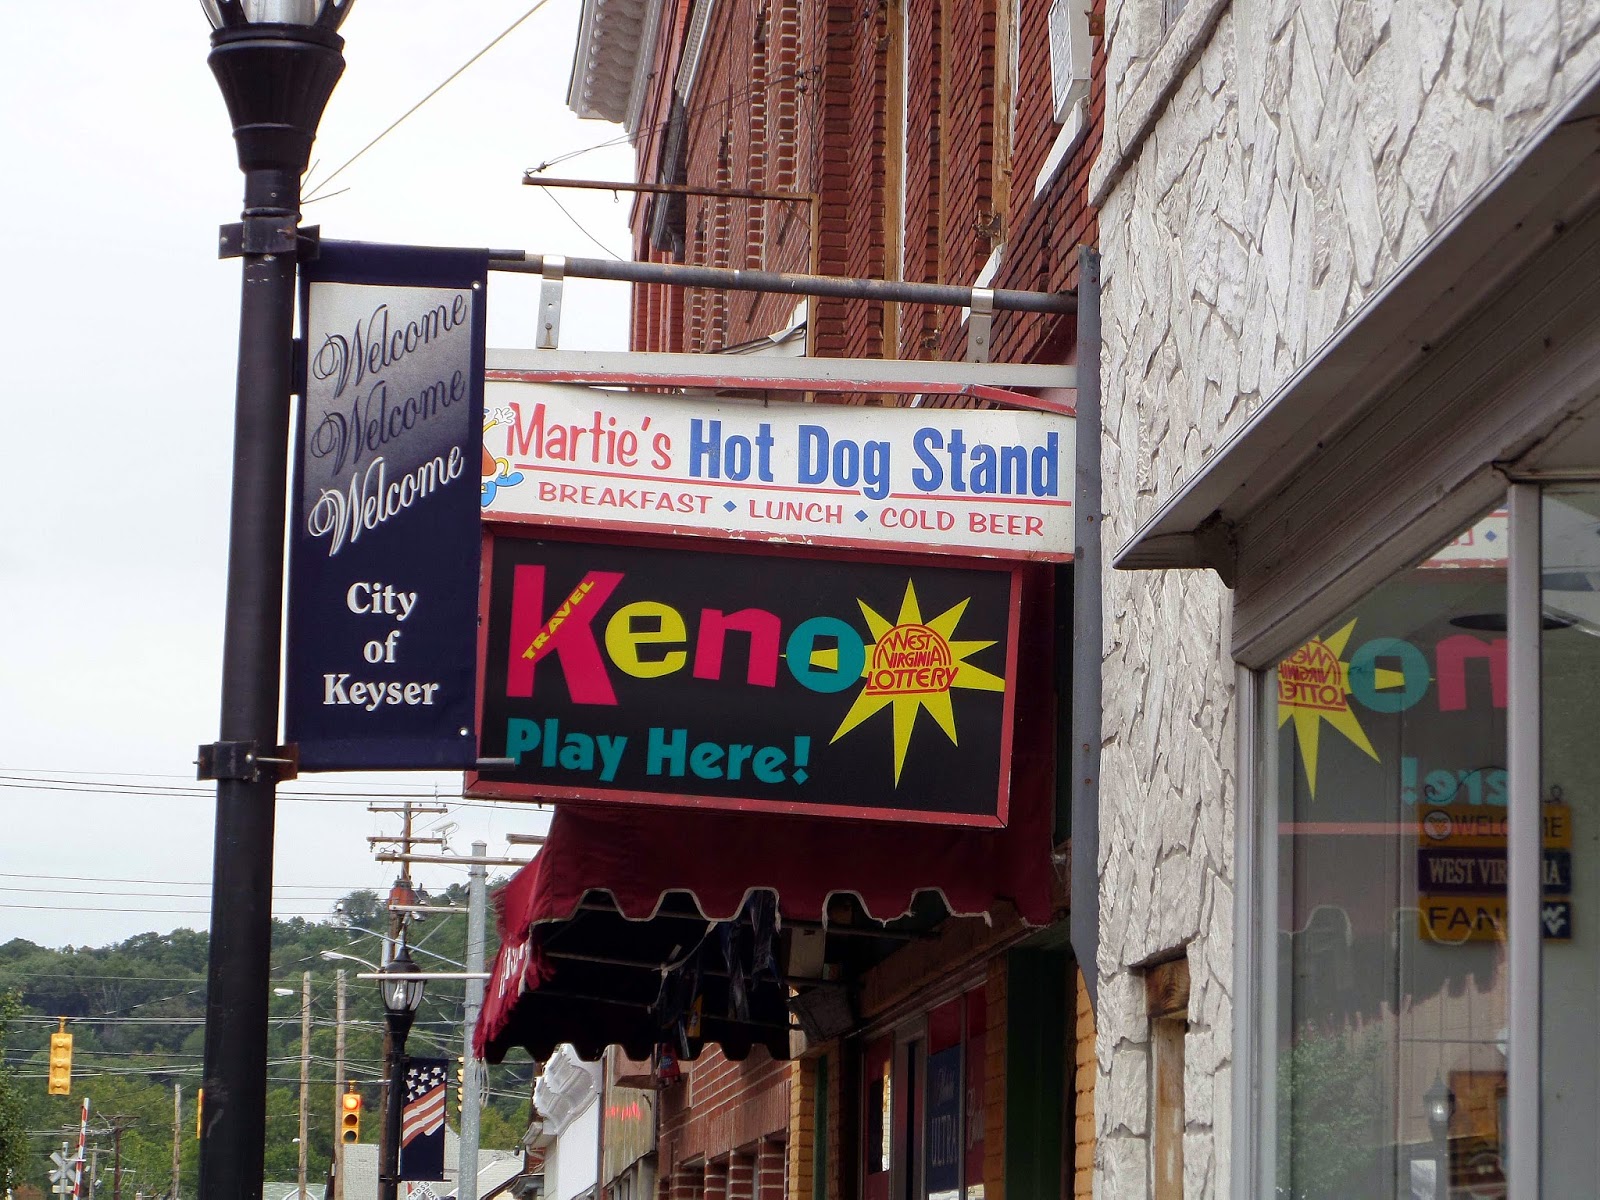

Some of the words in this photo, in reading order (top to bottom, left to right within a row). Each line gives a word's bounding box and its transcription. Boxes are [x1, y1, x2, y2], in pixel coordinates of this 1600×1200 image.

[312, 294, 467, 400] Welcome
[310, 370, 466, 476] Welcome
[506, 402, 672, 470] Martie's
[689, 418, 775, 483] Hot
[798, 424, 891, 500] Dog
[911, 427, 1059, 497] Stand
[308, 446, 464, 557] Welcome
[538, 481, 713, 514] BREAKFAST
[749, 499, 843, 524] LUNCH
[880, 507, 955, 531] COLD
[968, 512, 1044, 537] BEER
[346, 582, 418, 622] City
[521, 580, 595, 660] TRAVEL
[363, 630, 400, 664] of
[506, 564, 866, 706] Keno
[881, 645, 944, 669] VIRGINIA
[886, 628, 933, 651] WEST
[322, 674, 439, 712] Keyser
[865, 667, 959, 692] LOTTERY
[506, 717, 628, 782] Play
[646, 727, 811, 786] Here!
[1428, 857, 1476, 885] WEST
[1428, 906, 1501, 931] FAN
